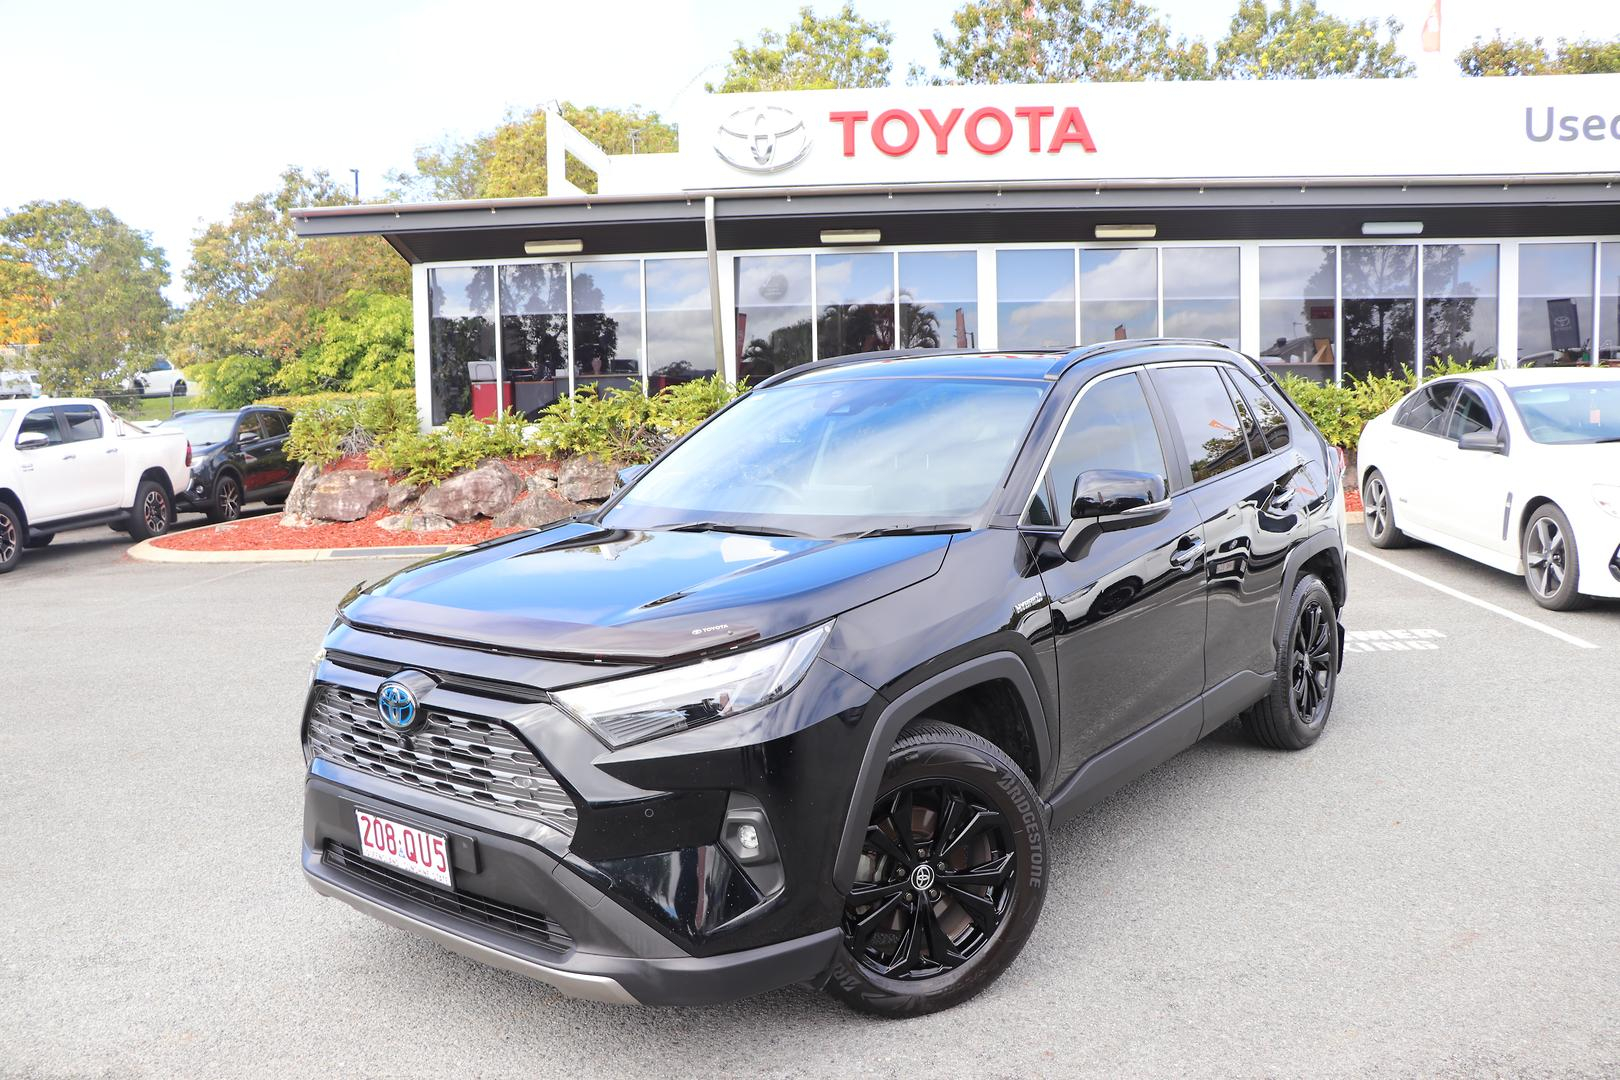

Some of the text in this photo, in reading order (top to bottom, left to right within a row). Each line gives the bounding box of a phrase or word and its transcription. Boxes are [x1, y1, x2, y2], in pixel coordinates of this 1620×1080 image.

[829, 106, 1097, 158] TOYOTA
[702, 623, 729, 633] TOYOTA
[996, 769, 1043, 889] BRIDGESTONE
